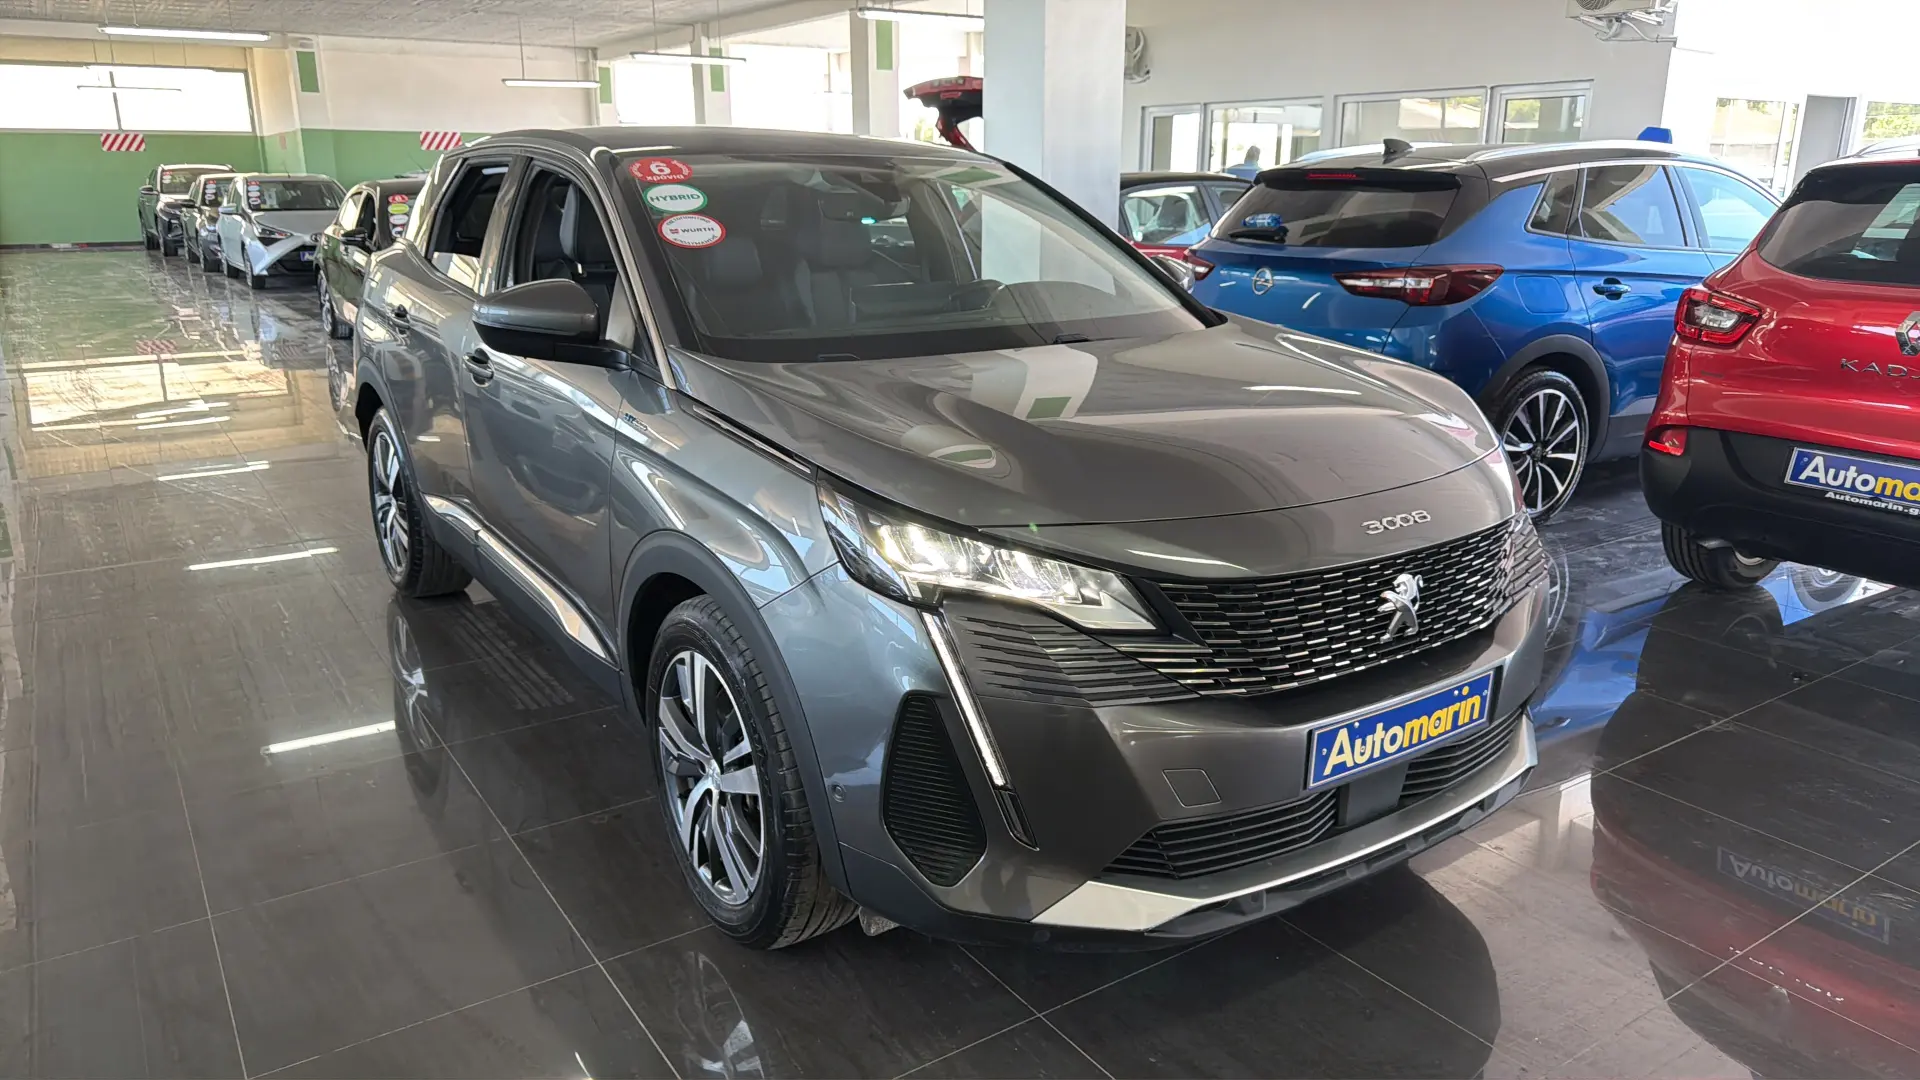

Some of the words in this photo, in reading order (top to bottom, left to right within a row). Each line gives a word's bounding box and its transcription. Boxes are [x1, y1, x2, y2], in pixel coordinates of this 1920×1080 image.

[649, 161, 671, 175] 6
[649, 193, 701, 203] HYBRID
[1825, 491, 1920, 516] Automarin.g
[1360, 509, 1432, 535] 3008
[1322, 685, 1482, 776] Automarin
